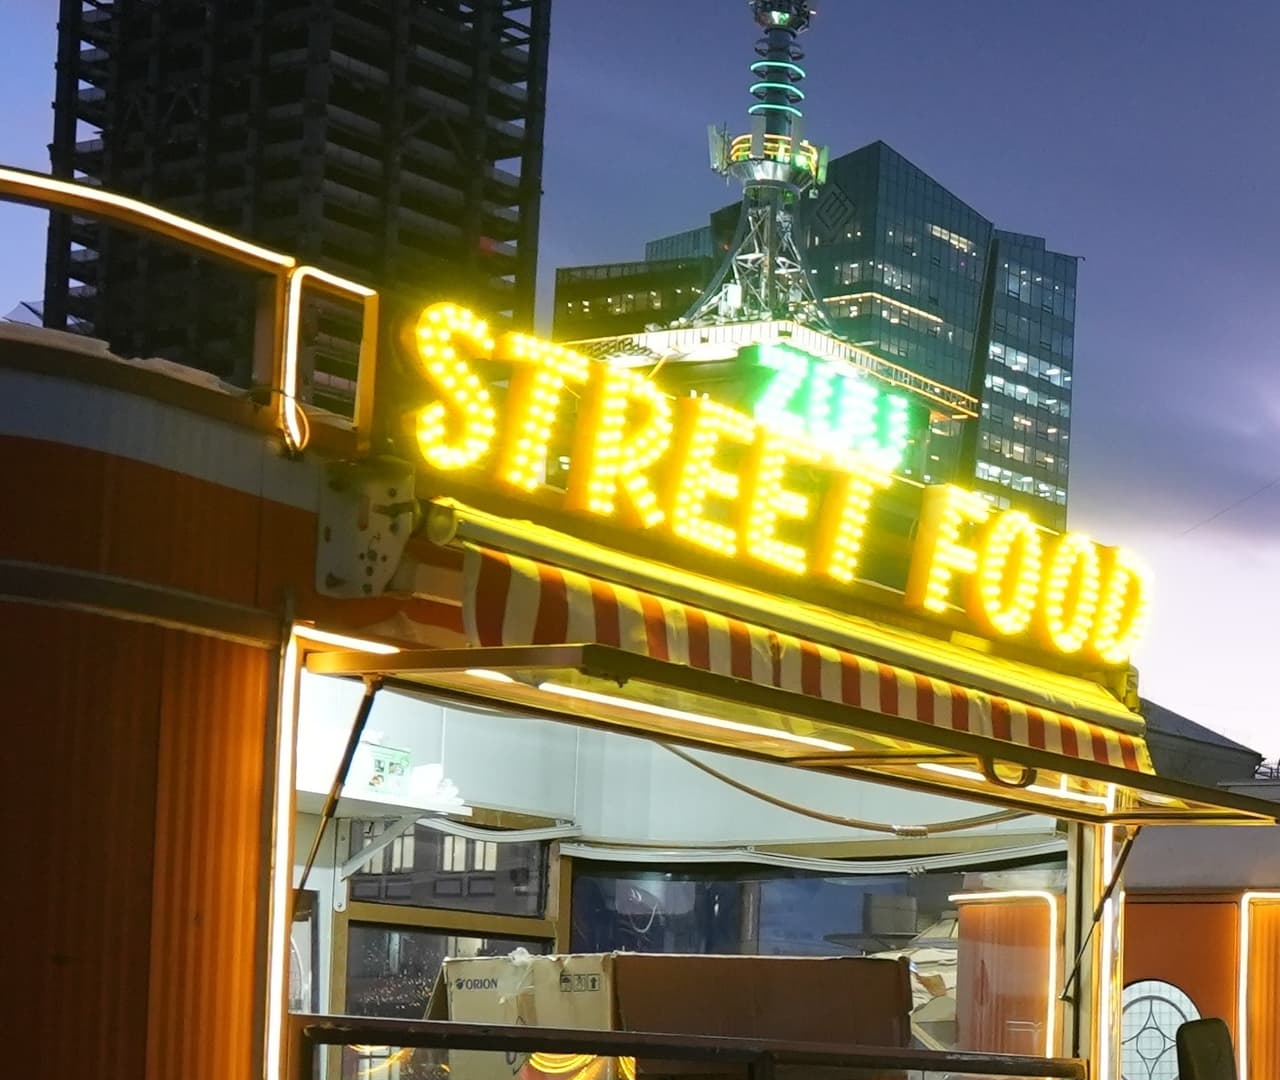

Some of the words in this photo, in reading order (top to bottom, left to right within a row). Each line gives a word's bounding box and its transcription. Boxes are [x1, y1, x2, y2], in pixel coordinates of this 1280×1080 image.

[415, 302, 893, 584] STREET
[924, 486, 1155, 664] FOOD
[465, 977, 498, 990] ORION
